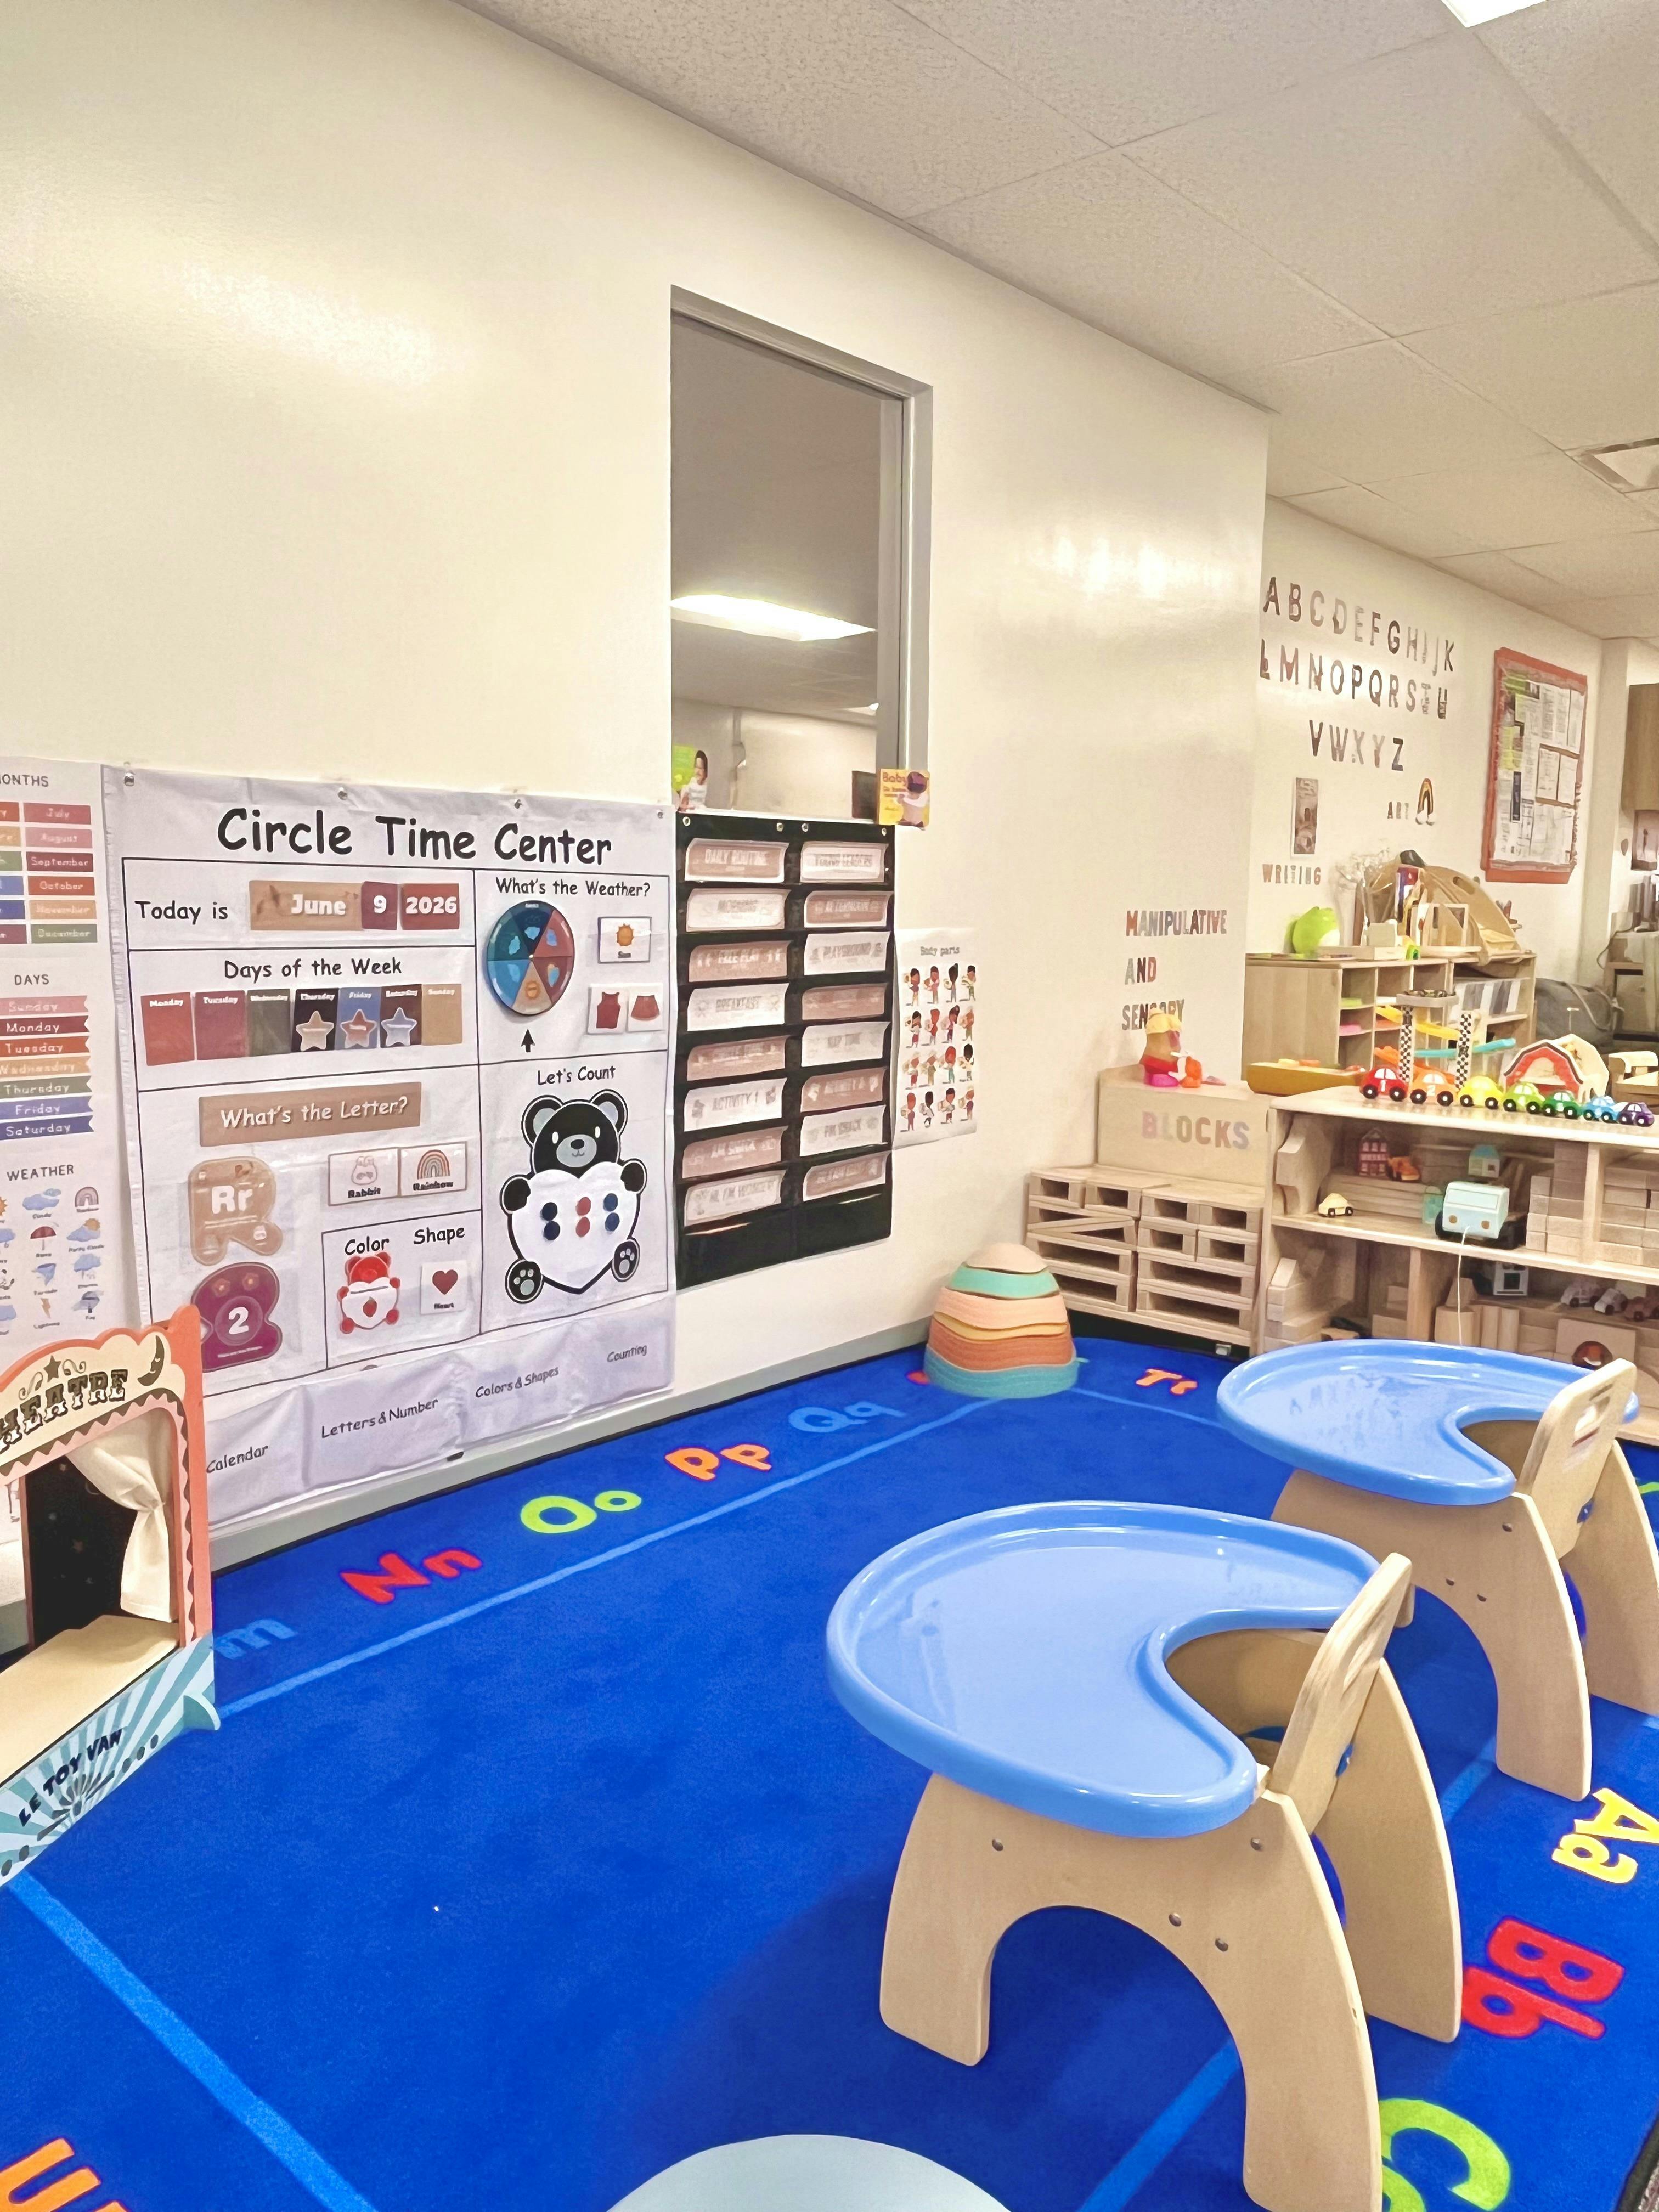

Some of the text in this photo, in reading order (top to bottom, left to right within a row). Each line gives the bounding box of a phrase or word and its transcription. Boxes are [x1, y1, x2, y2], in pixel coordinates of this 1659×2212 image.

[0, 774, 49, 787] ONTHS
[218, 808, 611, 865] Circle Time Center
[31, 856, 89, 867] September
[496, 877, 651, 897] What's the Weather?
[134, 900, 228, 925] Today is
[291, 894, 347, 915] June
[374, 895, 387, 913] 9
[405, 896, 458, 915] 2026
[1126, 909, 1227, 936] MANIPULATIVE
[14, 974, 49, 985] DAYS
[224, 957, 402, 984] Days of the Week
[1125, 957, 1156, 985] AND
[1122, 999, 1185, 1030] SENRY
[7, 1023, 60, 1034] Monday
[5, 1043, 63, 1054] Tuesday
[538, 1065, 616, 1085] Let's Count
[3, 1083, 70, 1095] Thursday
[1427, 1085, 1436, 1096] 2
[15, 1103, 61, 1115] Friday
[221, 1096, 408, 1128] What's the Letter?
[5, 1124, 71, 1137] Saturday
[1142, 1111, 1250, 1150] BLOCKS
[6, 1164, 74, 1181] WEATHER
[211, 1185, 253, 1214] Rr
[348, 1187, 381, 1198] Rabbit
[345, 1235, 390, 1256] Color
[413, 1227, 465, 1245] Shape
[228, 1307, 249, 1335] 2
[607, 1345, 647, 1363] Counting
[475, 1367, 559, 1398] Colors & Shapes
[321, 1398, 438, 1438] Letters & Number
[788, 1401, 906, 1433] Qq
[206, 1444, 268, 1474] Calendar
[665, 1444, 771, 1481] Pp
[521, 1489, 642, 1534] Oo
[340, 1552, 483, 1604] Nn
[19, 1728, 123, 1827] LE TOY VAN
